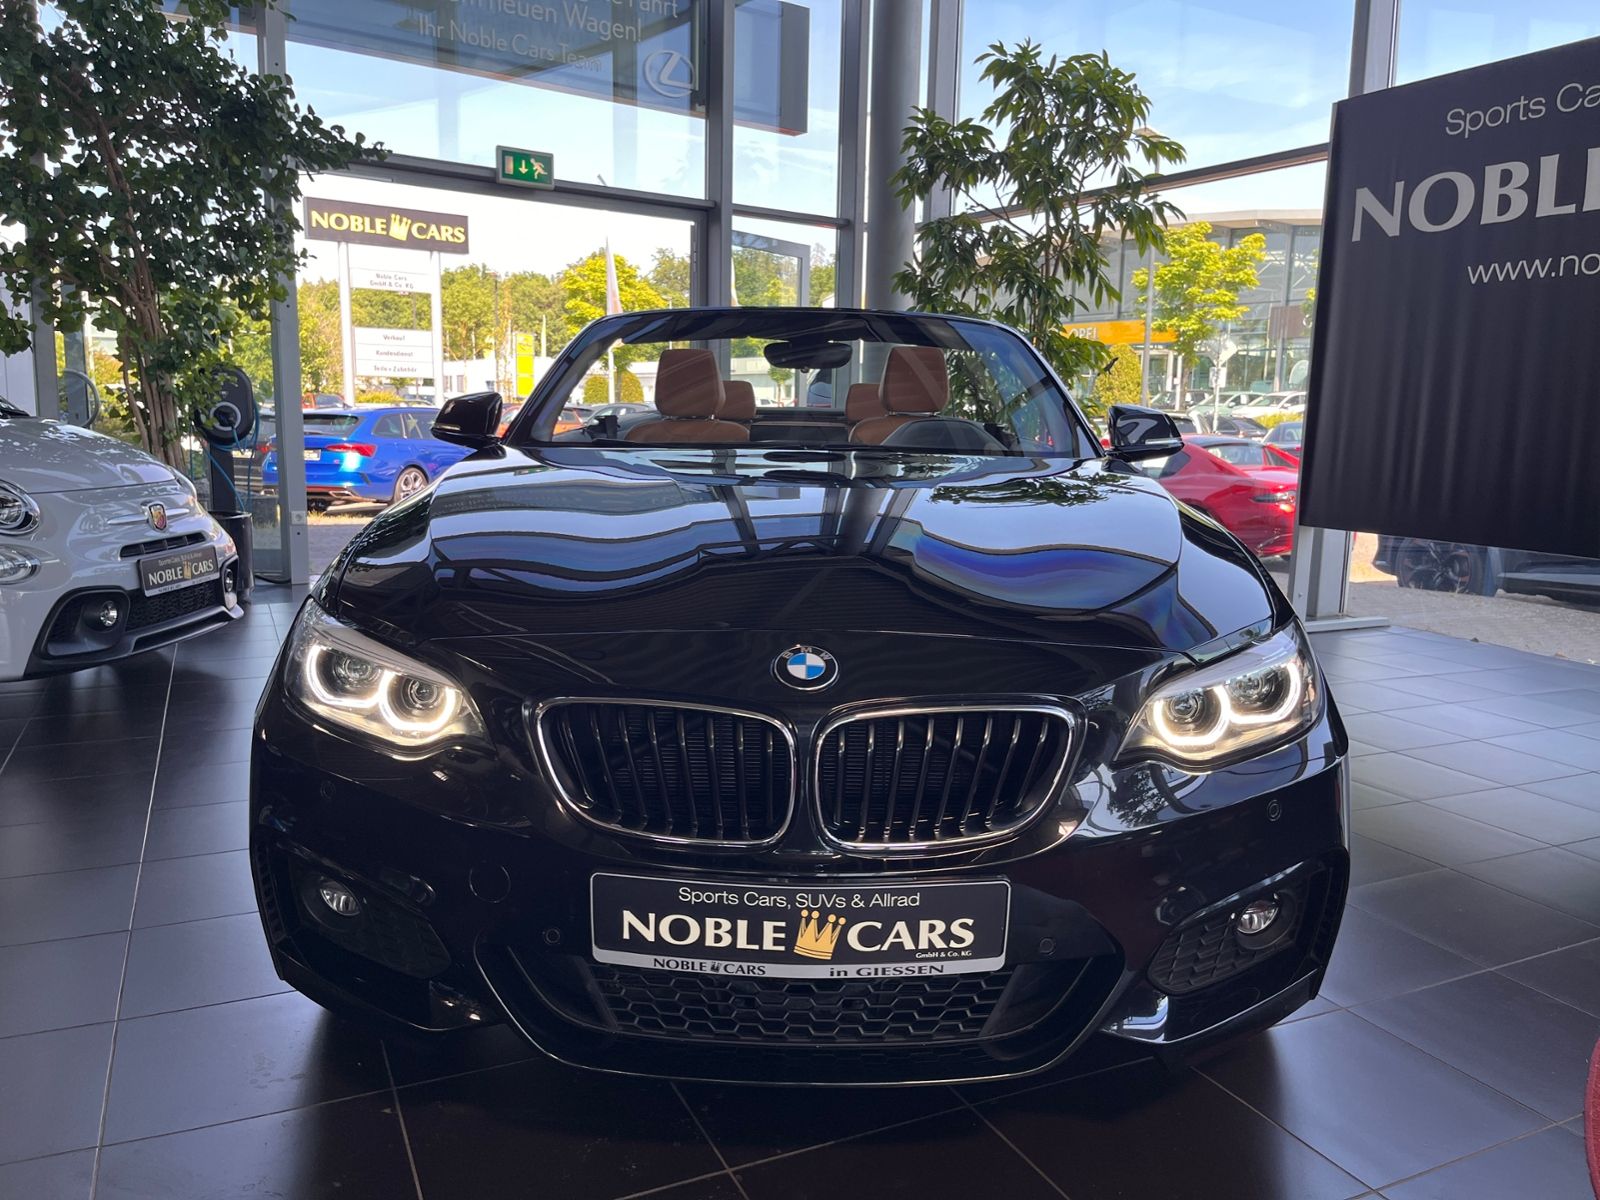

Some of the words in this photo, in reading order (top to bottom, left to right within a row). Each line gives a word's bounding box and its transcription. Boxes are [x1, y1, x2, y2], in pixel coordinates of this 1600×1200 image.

[563, 1, 642, 42] Wagen!
[418, 13, 445, 38] Ihr
[450, 19, 508, 51] Noble
[512, 34, 554, 61] Cars
[559, 43, 602, 72] Team
[1445, 96, 1546, 138] Sports
[311, 211, 387, 236] NOBLE
[411, 222, 466, 244] CARS
[1467, 253, 1600, 284] www.no
[148, 566, 183, 586] NOBLE
[192, 560, 214, 575] CARS
[678, 886, 739, 906] Sports
[743, 891, 791, 910] Cars,
[795, 892, 845, 908] SUVs
[851, 893, 865, 908] &
[868, 892, 920, 908] Allrad
[622, 910, 786, 952] NOBLE
[847, 917, 975, 952] CARS
[653, 957, 706, 972] NOBLE
[723, 962, 766, 976] CARS
[830, 967, 848, 977] in
[856, 965, 945, 977] GIESSEN
[915, 951, 938, 959] GmbH
